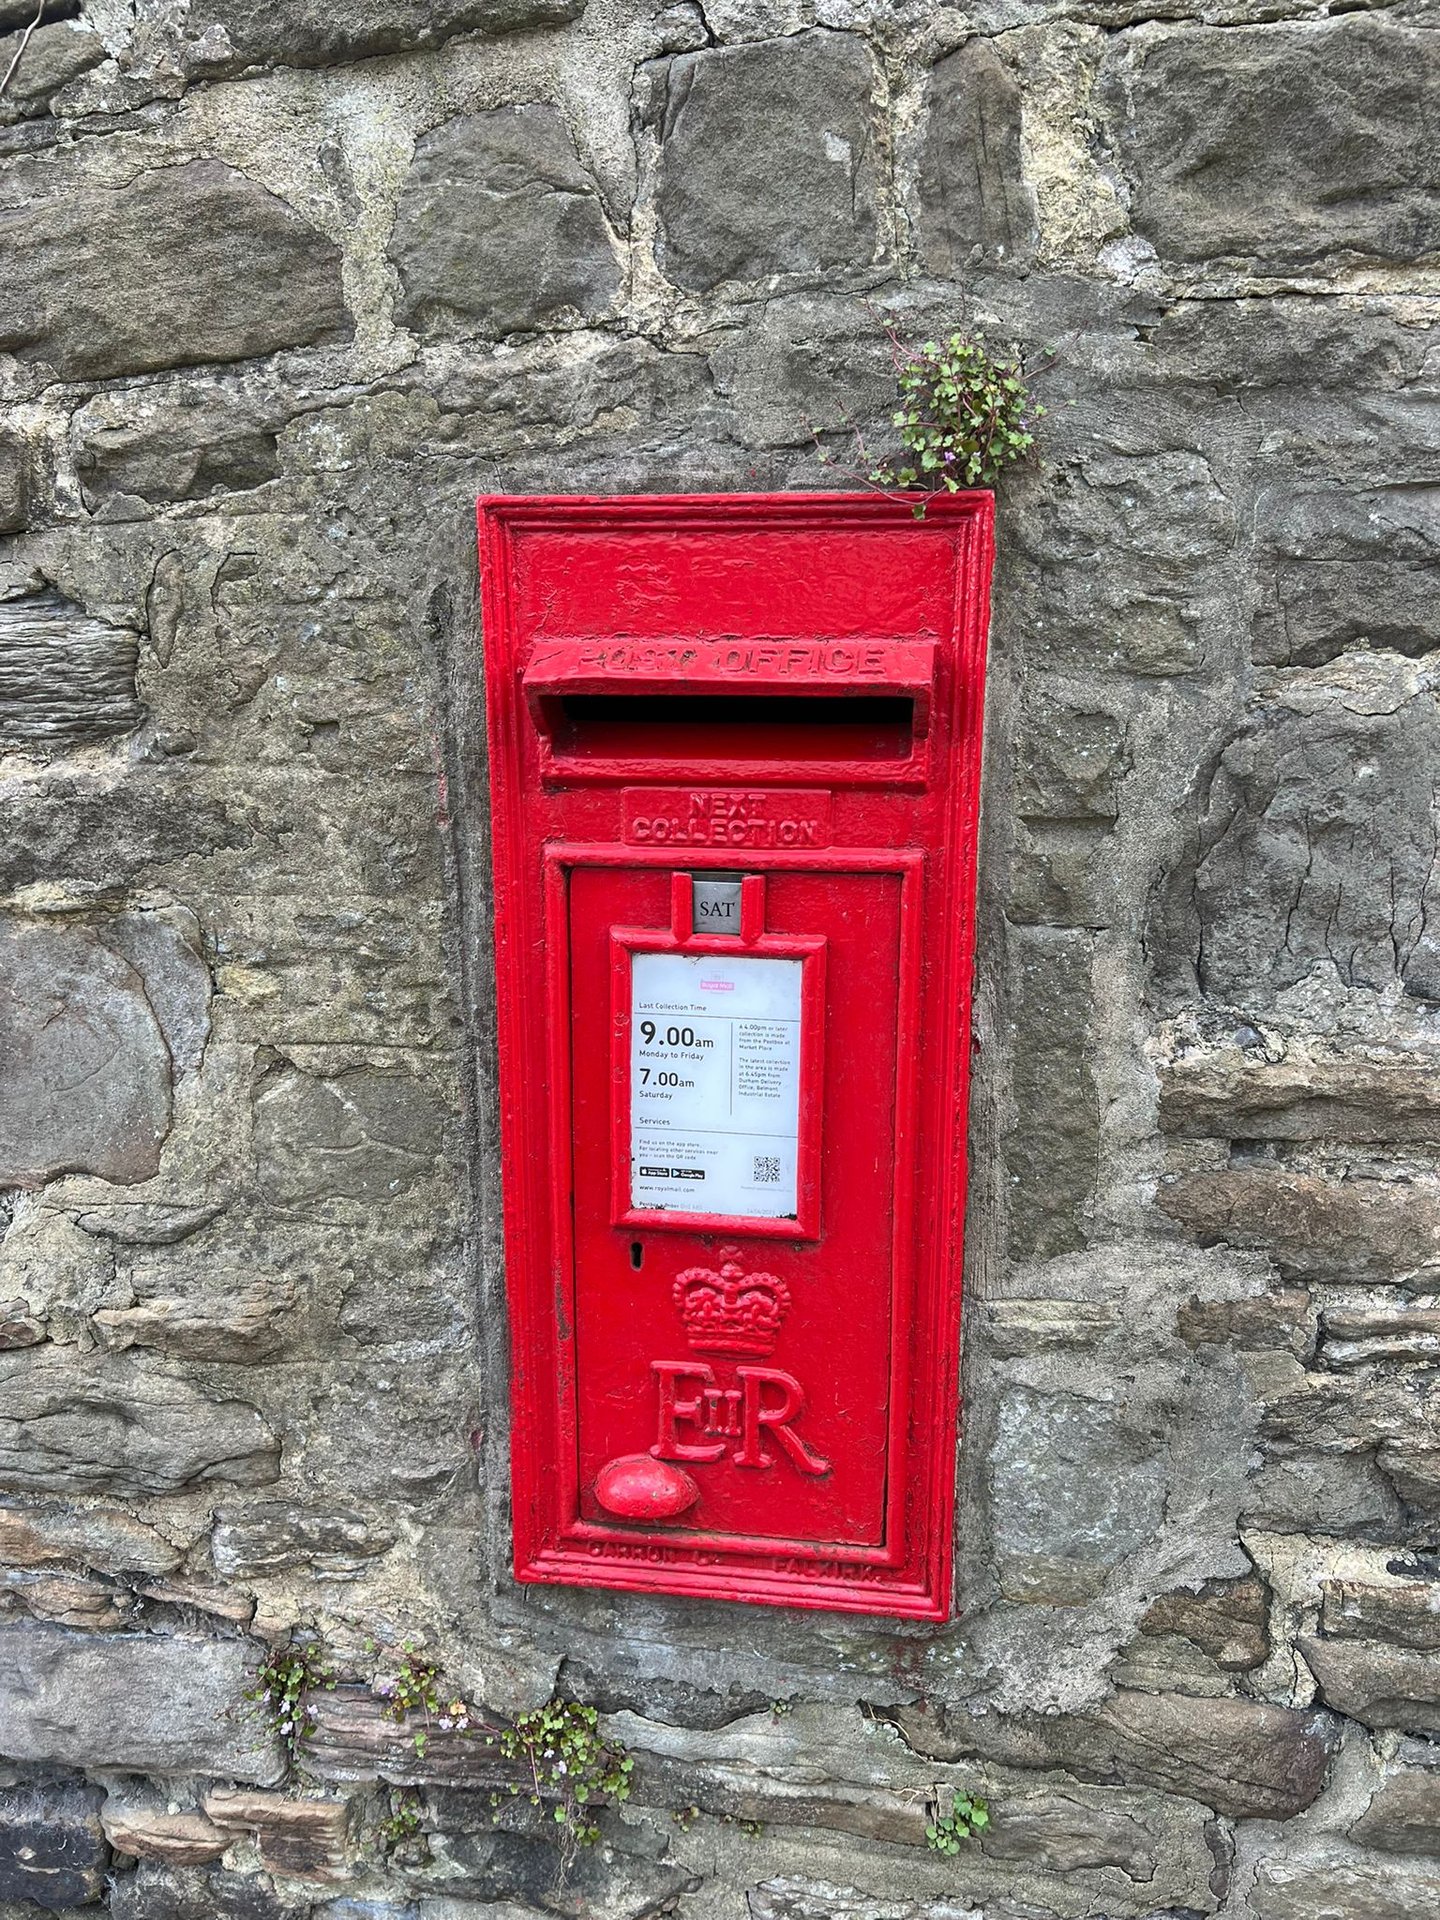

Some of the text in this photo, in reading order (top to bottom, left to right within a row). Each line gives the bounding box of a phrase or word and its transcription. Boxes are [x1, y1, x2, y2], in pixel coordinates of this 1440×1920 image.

[578, 649, 887, 675] POST OFFICE
[690, 793, 767, 816] NEXT
[632, 817, 818, 842] COLLECTION
[699, 901, 736, 917] SAT
[656, 1002, 688, 1010] Collection
[640, 1020, 714, 1048] 9.00am
[639, 1050, 669, 1060] Monday
[680, 1052, 704, 1061] Friday
[639, 1068, 695, 1088] 7.00am
[639, 1090, 673, 1100] Saturday
[639, 1116, 671, 1126] Services
